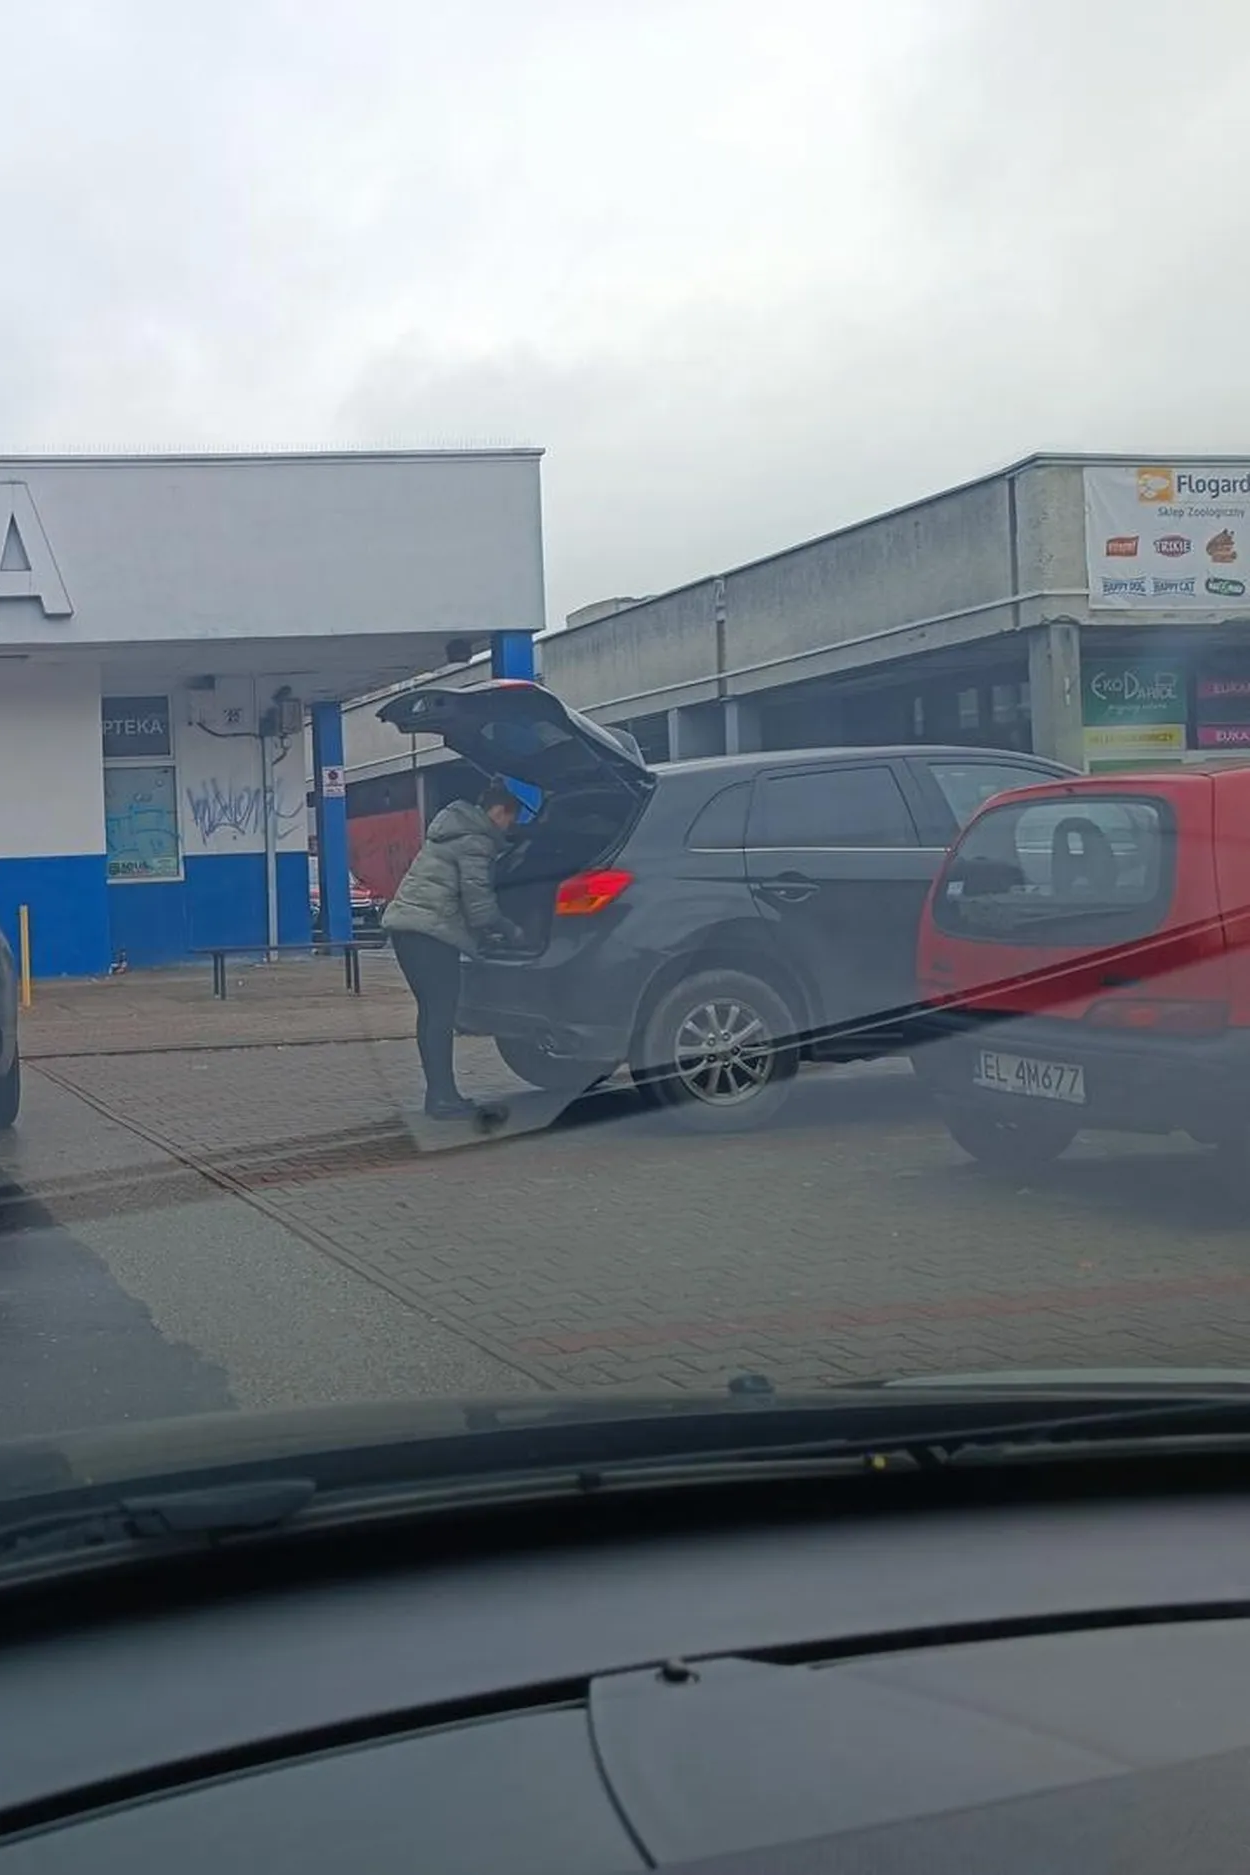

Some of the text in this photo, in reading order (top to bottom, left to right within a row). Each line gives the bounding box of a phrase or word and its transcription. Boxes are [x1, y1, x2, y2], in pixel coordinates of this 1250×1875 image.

[1156, 505, 1246, 520] Sklep Zoologiczny
[983, 1053, 1080, 1095] EL 4M677
